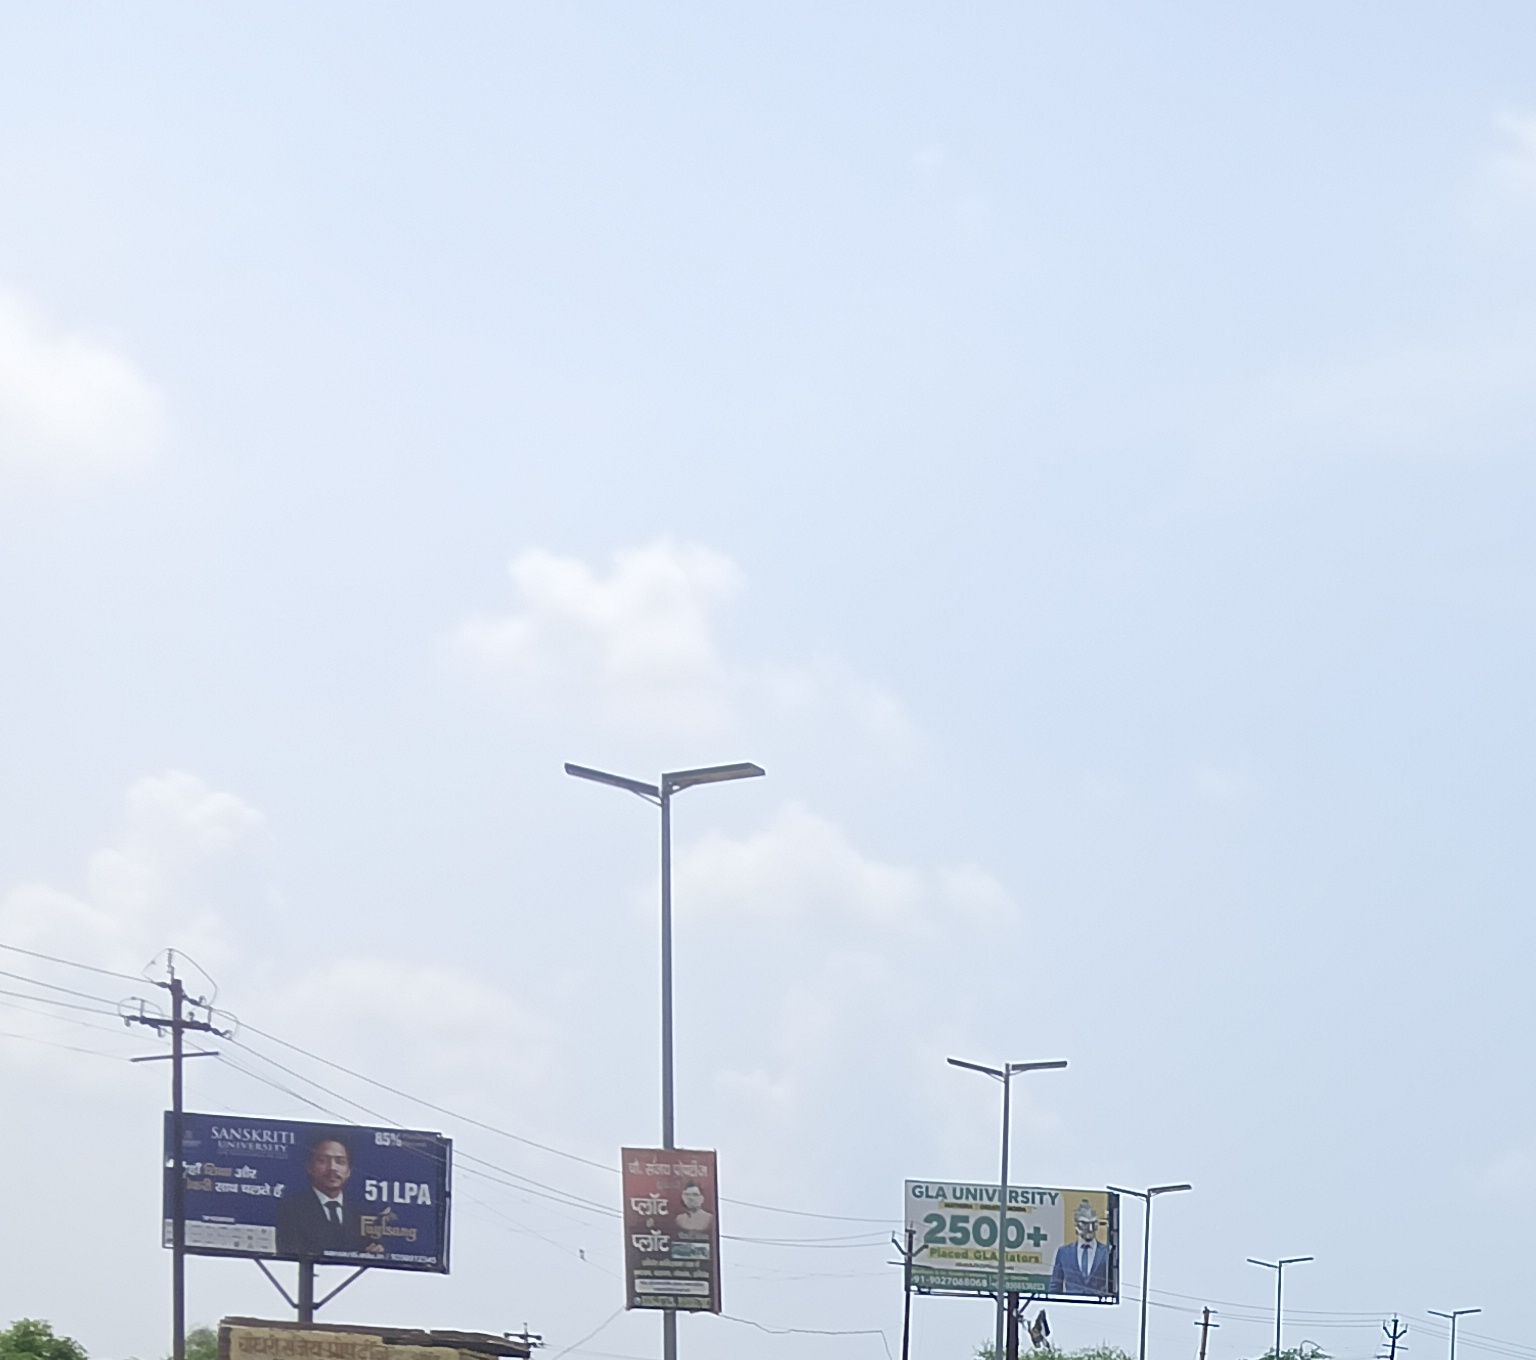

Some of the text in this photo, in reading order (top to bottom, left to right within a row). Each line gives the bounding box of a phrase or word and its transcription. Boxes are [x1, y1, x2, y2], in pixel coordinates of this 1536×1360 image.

[211, 1126, 295, 1145] SANSKRITI
[375, 1131, 402, 1147] 85%
[217, 1140, 288, 1153] UNIVERSITY
[234, 1165, 257, 1179] और
[215, 1182, 239, 1193] साथ
[364, 1179, 432, 1205] 51 LPA
[911, 1185, 1060, 1206] GLA UNIVRSITY
[630, 1192, 669, 1215] प्लॉट
[631, 1229, 671, 1252] प्लॉट
[923, 1213, 1048, 1249] 2500+
[929, 1247, 1040, 1264] Placed GLAiators
